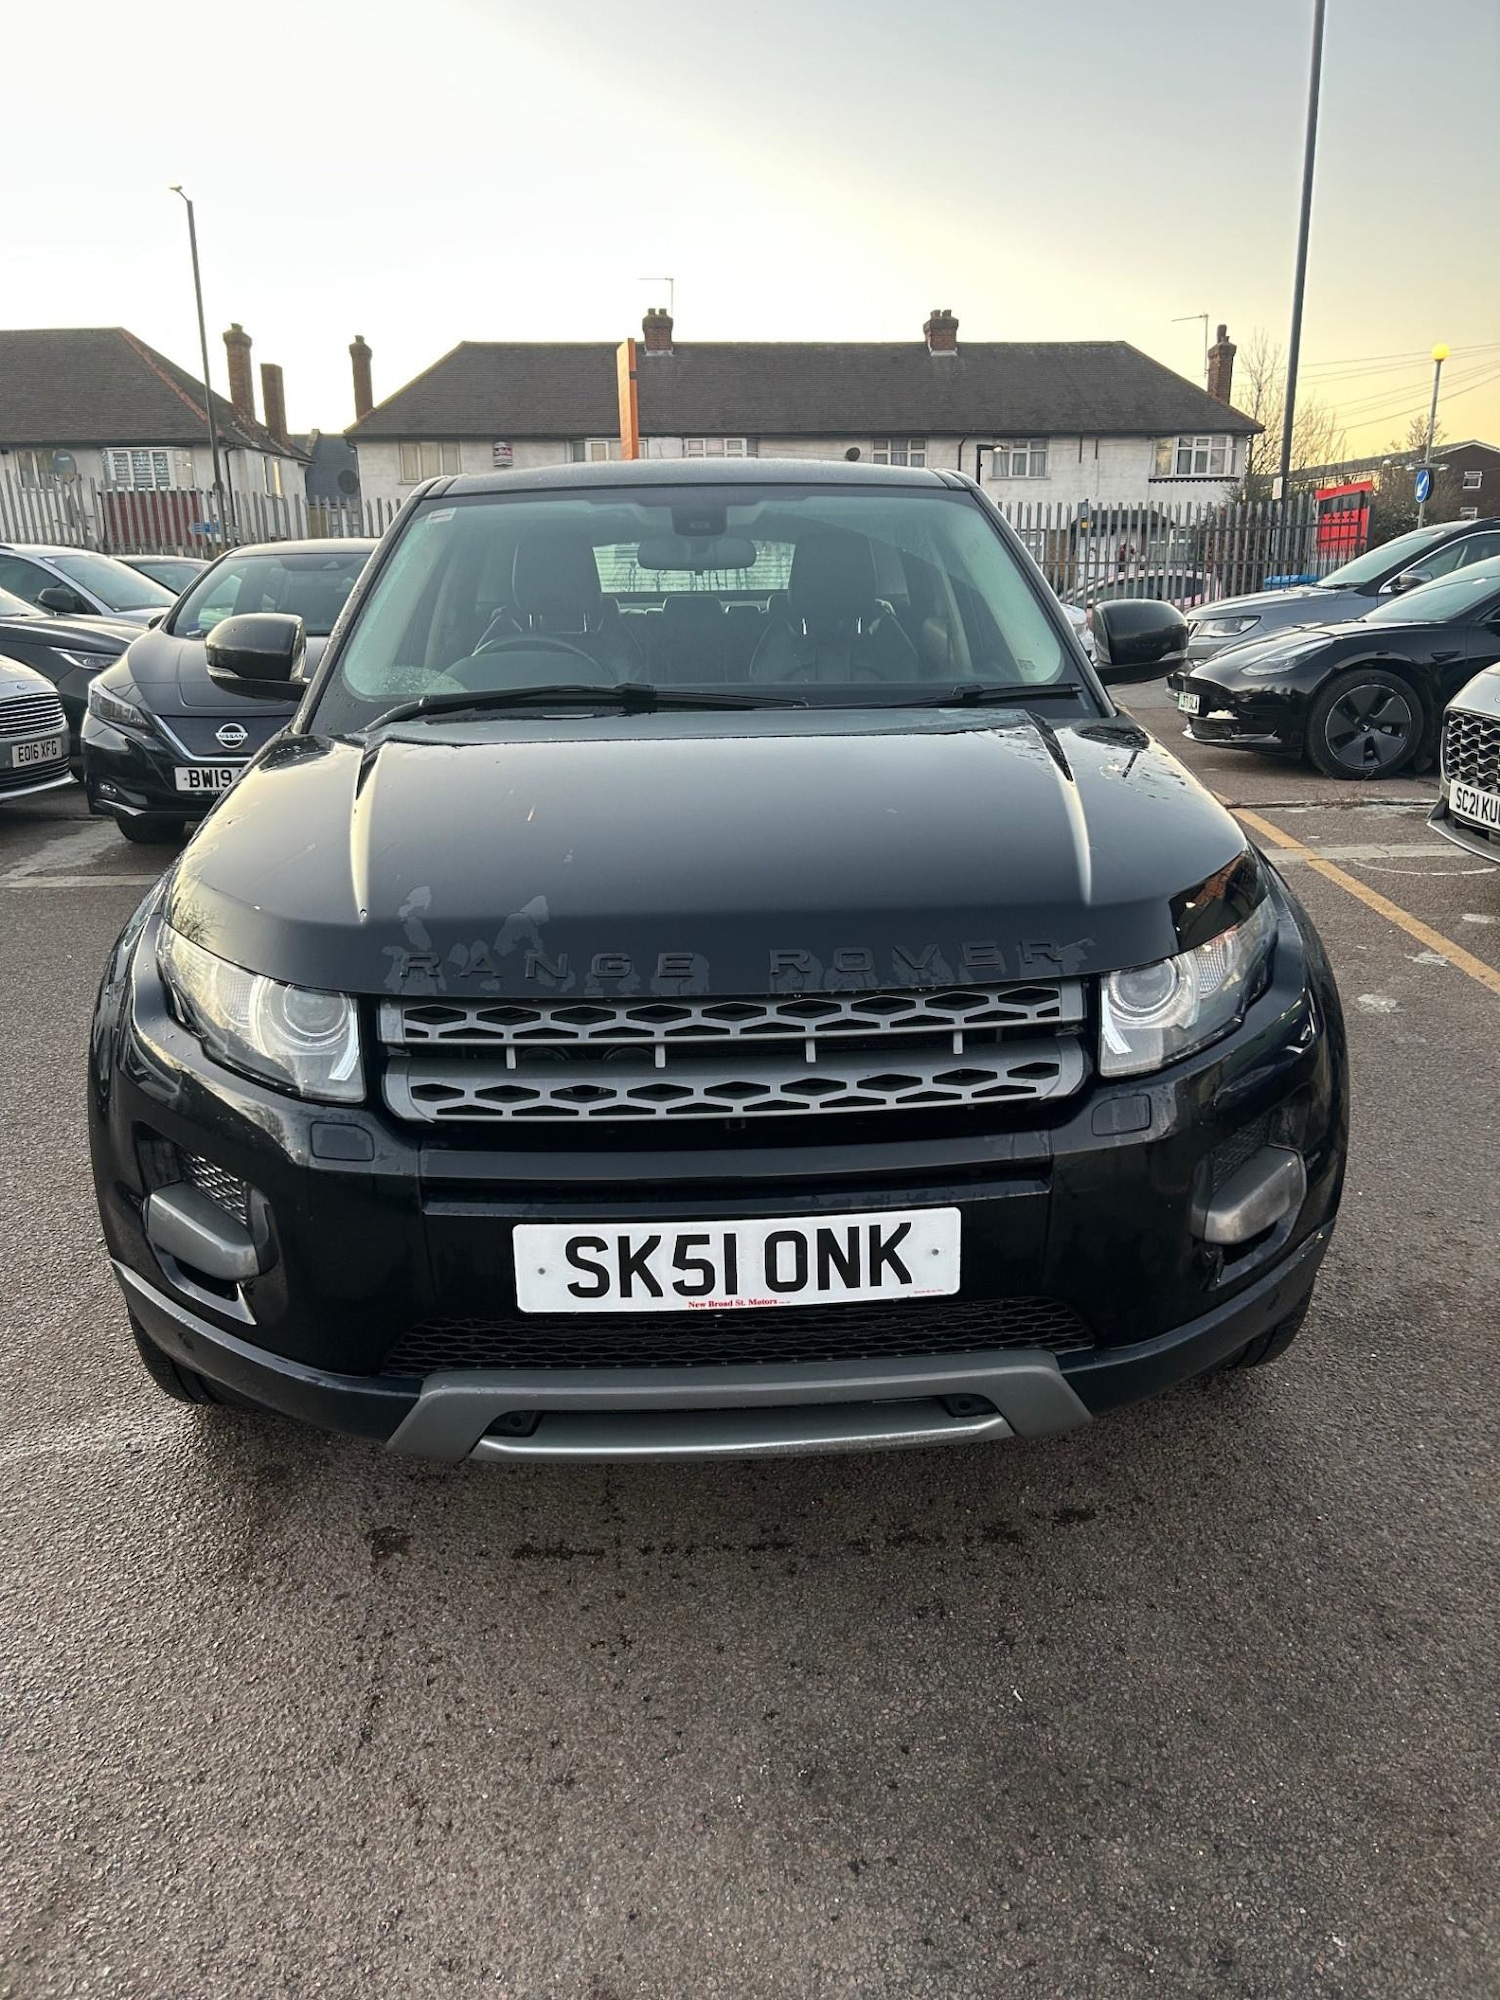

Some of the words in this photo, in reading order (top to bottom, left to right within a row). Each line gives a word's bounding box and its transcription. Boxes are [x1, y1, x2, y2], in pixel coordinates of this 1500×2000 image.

[41, 740, 57, 758] XFG
[188, 769, 232, 788] BW19
[1456, 787, 1479, 817] SC21
[1481, 796, 1500, 825] KU
[400, 952, 695, 979] RANGE
[769, 940, 1063, 975] ROVER
[565, 1232, 738, 1298] SK51
[764, 1222, 913, 1293] ONK
